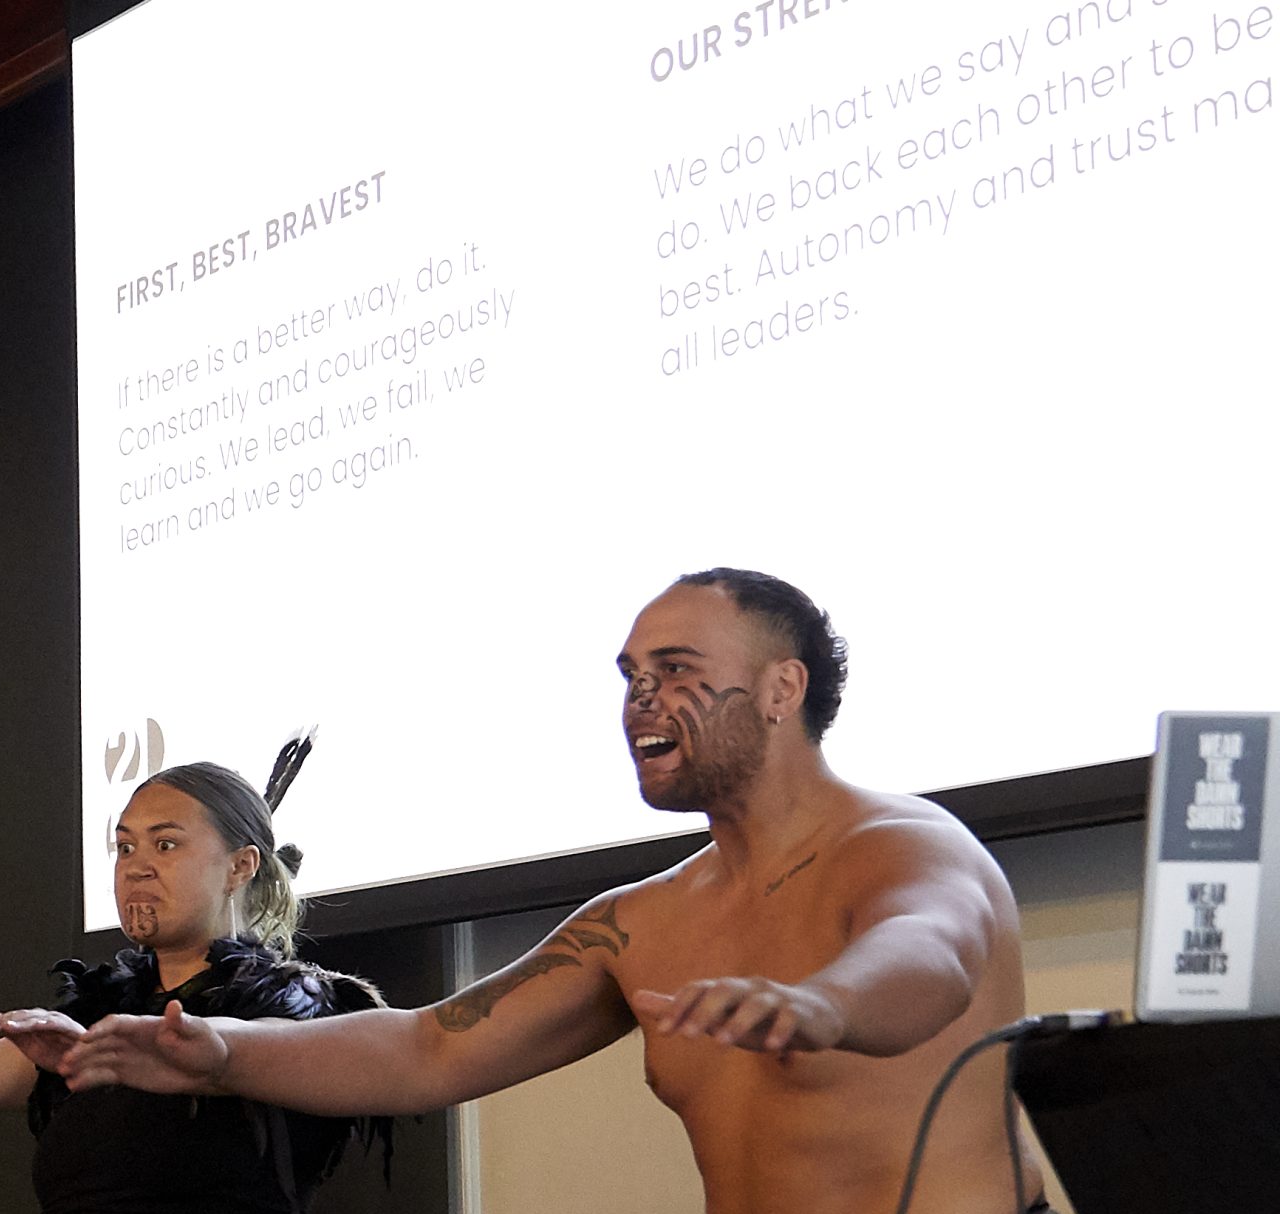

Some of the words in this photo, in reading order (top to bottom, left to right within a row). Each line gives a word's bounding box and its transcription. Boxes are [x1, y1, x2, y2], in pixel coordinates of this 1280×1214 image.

[649, 24, 723, 83] OUR
[733, 0, 849, 49] STRE
[653, 157, 708, 200] We
[720, 133, 766, 175] do
[777, 85, 873, 152] what
[885, 64, 942, 110] we
[957, 27, 1030, 83] say
[656, 219, 708, 260] do.
[719, 191, 776, 235] We
[789, 145, 884, 212] back
[896, 103, 1000, 170] each
[1016, 55, 1133, 126] other
[1148, 35, 1195, 77] to
[1212, 5, 1274, 56] be
[659, 263, 742, 319] best.
[755, 188, 957, 288] Autonomy
[972, 143, 1055, 209] and
[1071, 104, 1176, 175] trust
[116, 260, 185, 315] FIRST,
[192, 229, 258, 283] BEST,
[265, 169, 387, 252] BRAVEST
[118, 376, 130, 410] If
[137, 358, 199, 402] there
[207, 344, 225, 376] is
[232, 338, 248, 365] a
[257, 303, 336, 356] better
[343, 277, 407, 321] way,
[416, 256, 453, 293] do
[463, 241, 486, 276] it.
[118, 386, 249, 457] Constantly
[258, 358, 308, 406] and
[317, 287, 516, 384] courageously
[660, 331, 698, 377] all
[712, 290, 859, 361] leaders.
[119, 455, 212, 506] curious.
[219, 436, 259, 471] We
[267, 405, 331, 456] lead,
[338, 395, 378, 430] we
[386, 368, 434, 414] fail,
[443, 357, 486, 393] we
[120, 514, 179, 554] learn
[187, 487, 235, 532] and
[244, 480, 280, 513] we
[289, 466, 323, 510] go
[331, 432, 419, 490] again.
